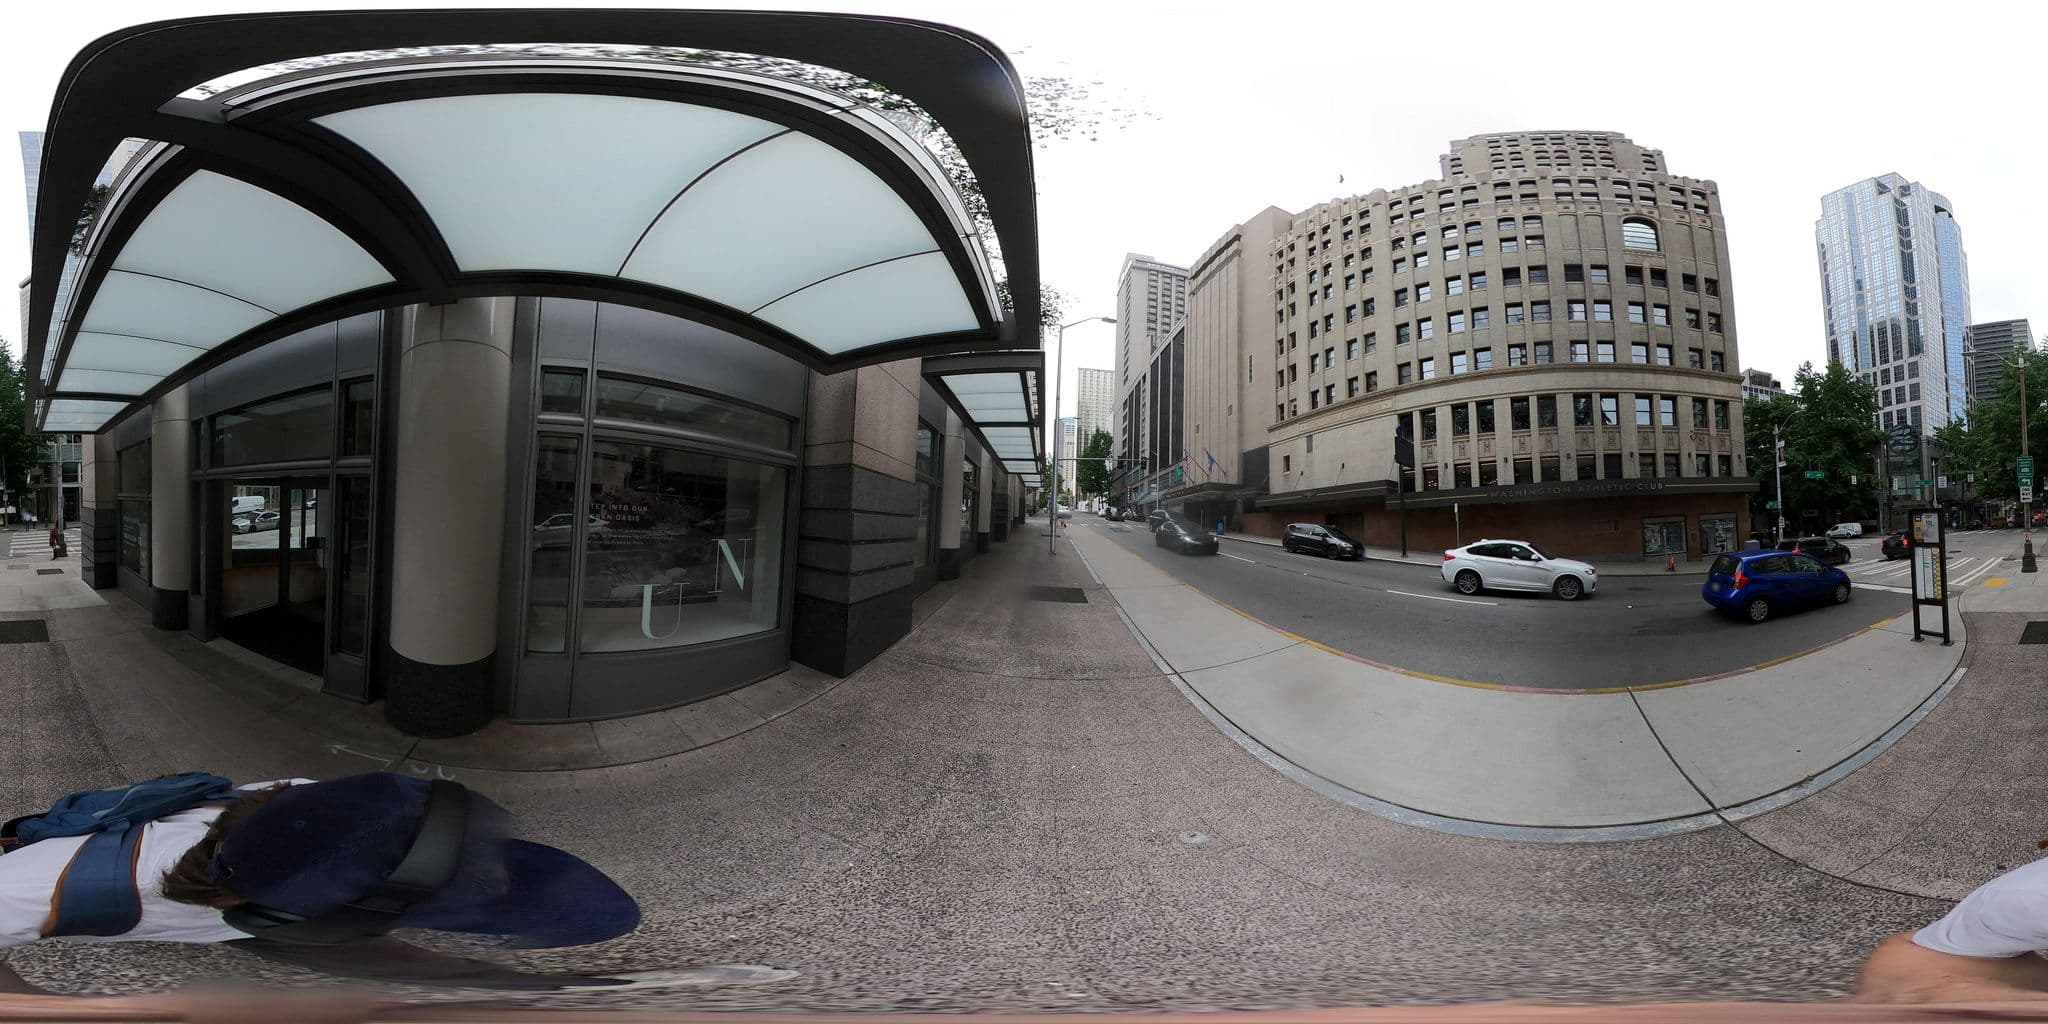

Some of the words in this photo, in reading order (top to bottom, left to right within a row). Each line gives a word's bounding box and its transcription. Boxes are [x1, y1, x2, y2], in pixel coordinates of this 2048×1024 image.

[1489, 486, 1571, 499] WASHINGTON
[1577, 482, 1631, 494] ATHLETIC
[1636, 481, 1664, 491] CLUB
[608, 503, 629, 511] INTO
